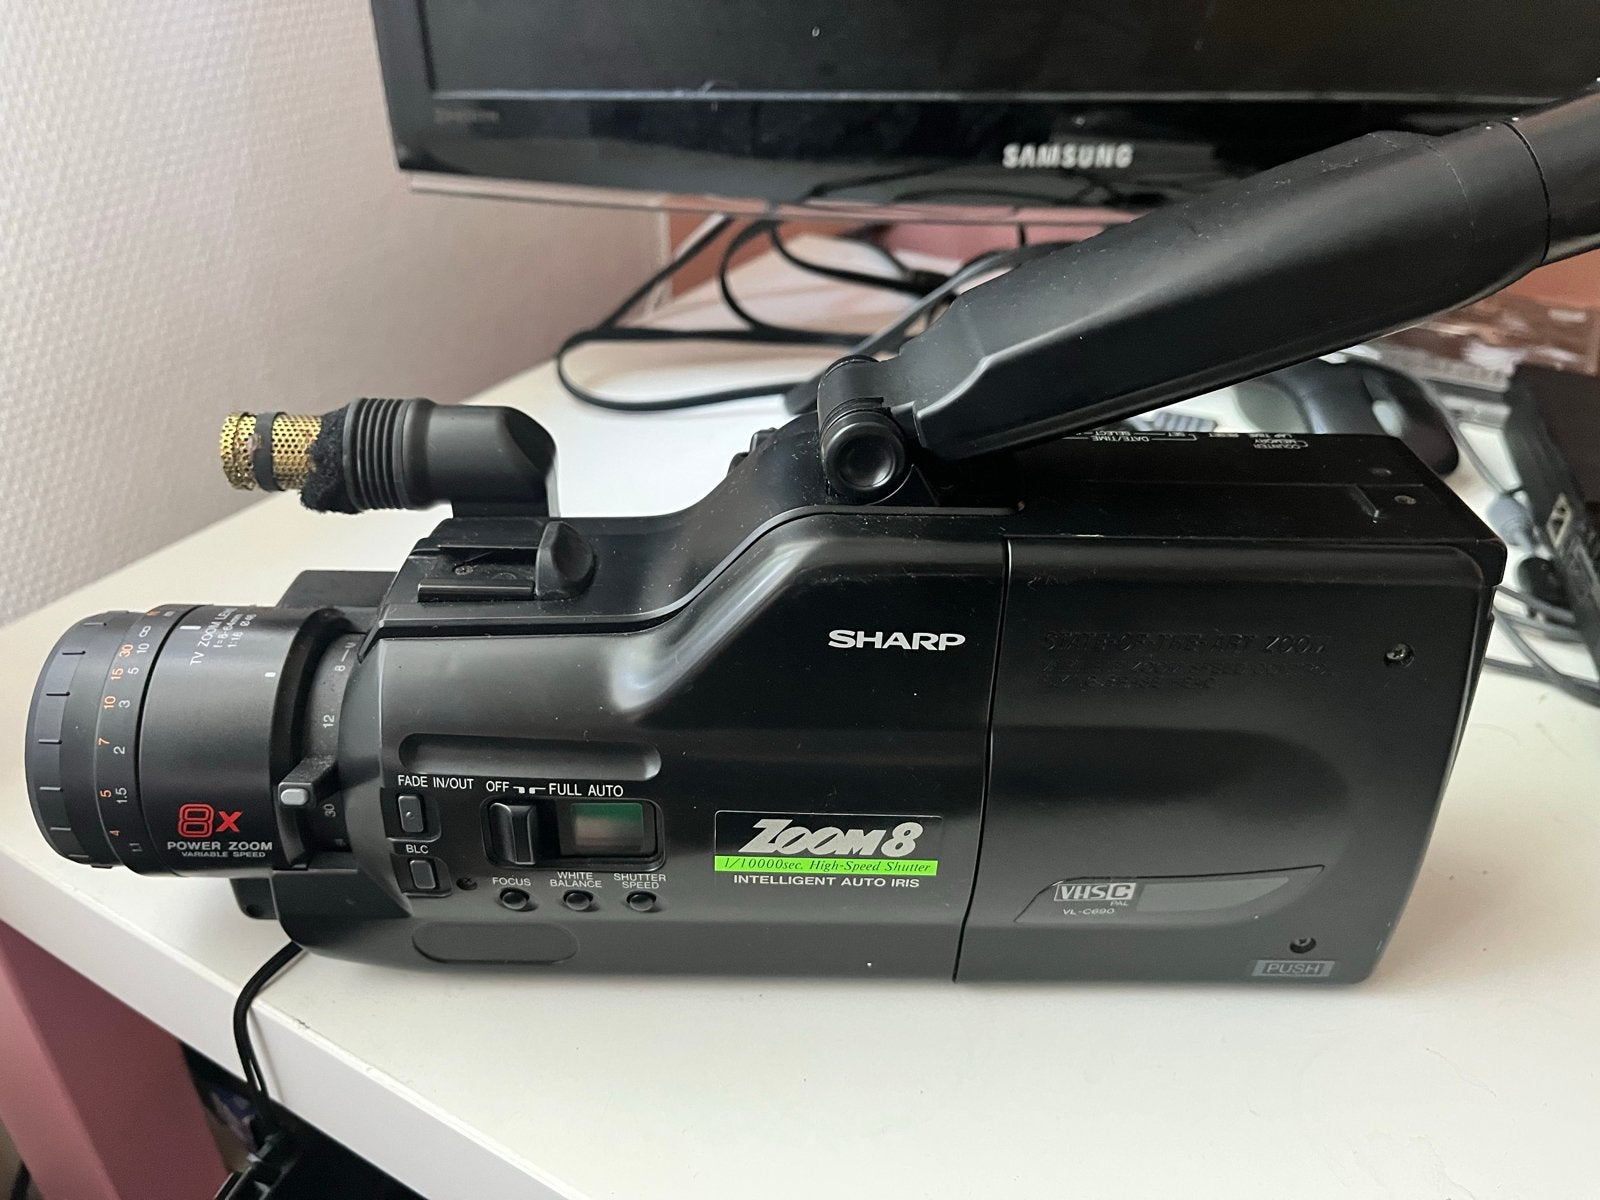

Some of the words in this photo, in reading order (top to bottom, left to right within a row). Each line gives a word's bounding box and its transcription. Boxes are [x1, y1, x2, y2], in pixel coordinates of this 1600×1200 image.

[1002, 142, 1134, 168] SAMSUNG
[189, 651, 205, 666] TV
[197, 621, 223, 648] ZOOM
[828, 629, 966, 651] SHARP
[119, 644, 133, 657] 30
[137, 643, 150, 654] 10
[111, 667, 124, 680] 15
[128, 667, 139, 675] 5
[104, 695, 116, 709] 10
[119, 700, 130, 708] 3
[323, 714, 335, 728] 12
[98, 737, 110, 745] 7
[113, 746, 126, 755] 2
[398, 775, 428, 787] FADE
[433, 777, 474, 790] IN/OUT
[100, 789, 112, 798] 5
[486, 780, 510, 792] OFF
[549, 783, 582, 796] FULL
[588, 784, 624, 797] AUTO
[323, 803, 336, 817] 30
[167, 841, 221, 851] POWER
[228, 841, 273, 851] ZOOM
[405, 844, 429, 855] BLC
[809, 860, 881, 872] High-Speed
[884, 861, 931, 872] Shutter
[492, 877, 531, 886] FOCUS
[557, 872, 593, 880] WHITE
[613, 873, 667, 882] SHUTTER
[733, 874, 836, 886] INTELLIGENT
[841, 877, 886, 887] AUTO
[891, 878, 920, 888] IRIS
[550, 879, 602, 888] BALANCE
[622, 881, 659, 889] SPEED
[1266, 962, 1322, 975] PUSH
